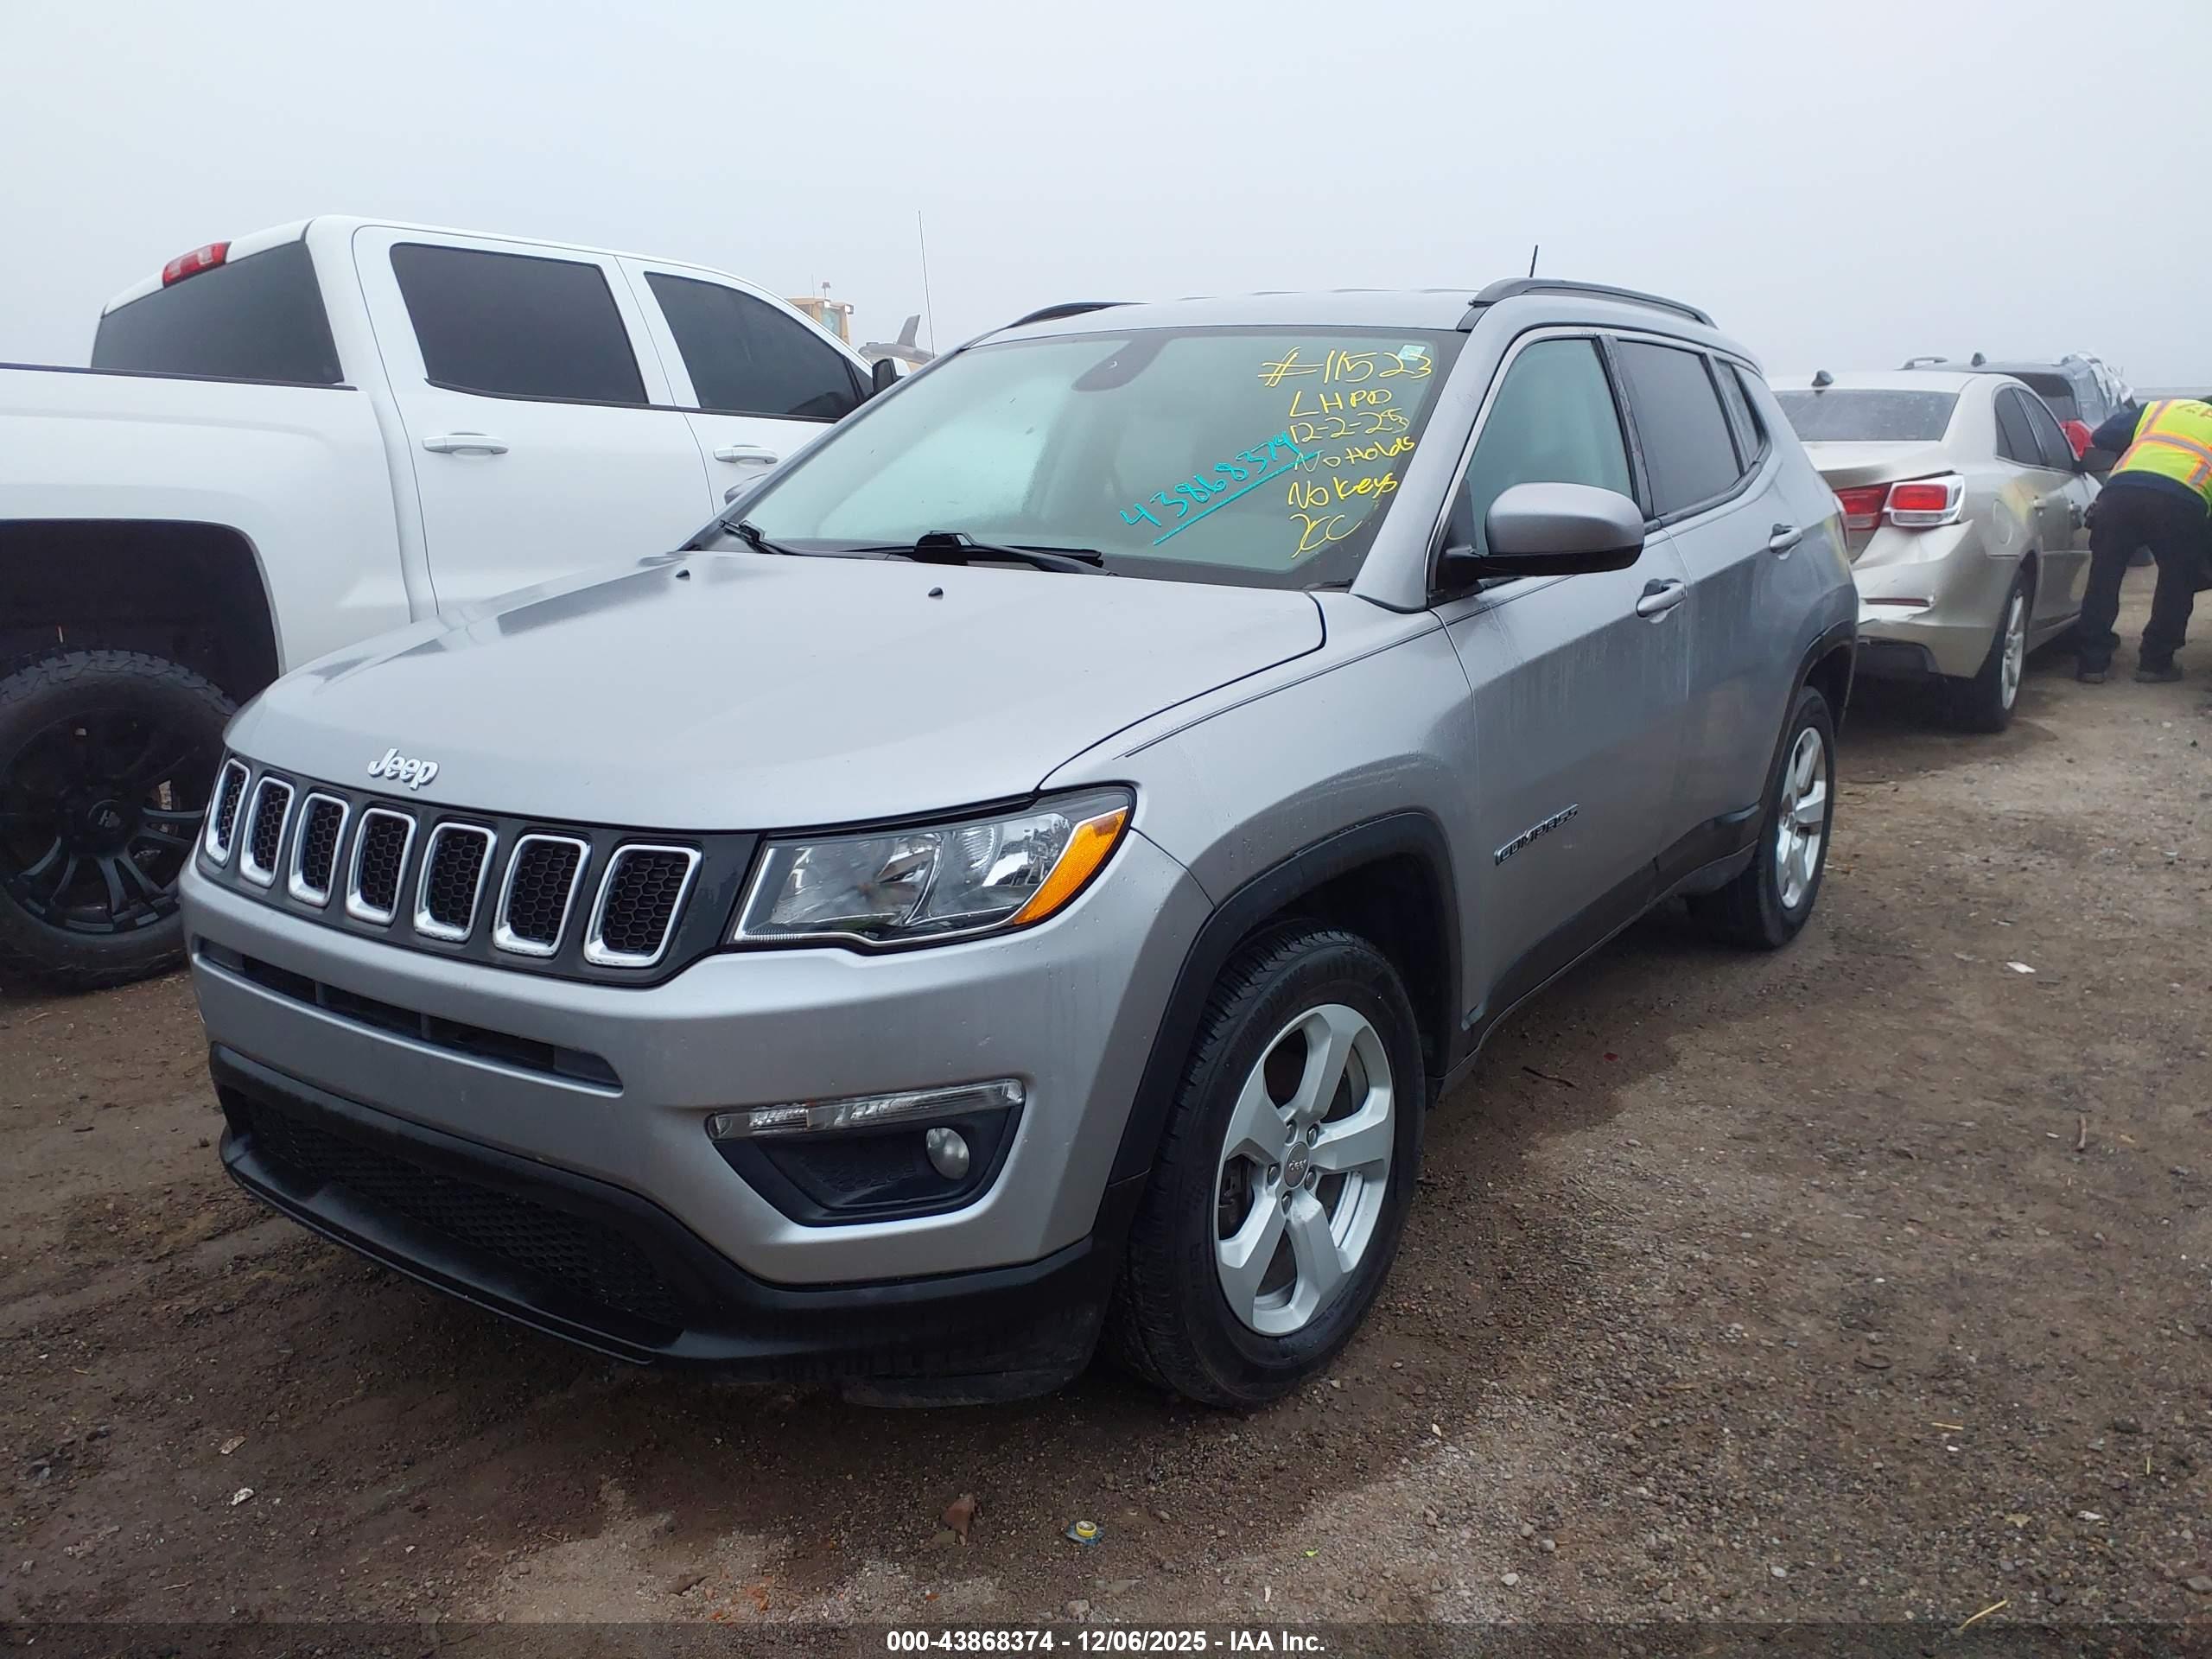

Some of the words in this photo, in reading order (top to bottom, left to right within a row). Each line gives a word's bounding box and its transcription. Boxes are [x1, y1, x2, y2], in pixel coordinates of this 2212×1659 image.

[1120, 430, 1300, 527] 43868374
[1294, 449, 1341, 473] No
[1288, 480, 1329, 510] No
[367, 748, 439, 791] Jeep
[1494, 803, 1579, 866] COMPASS
